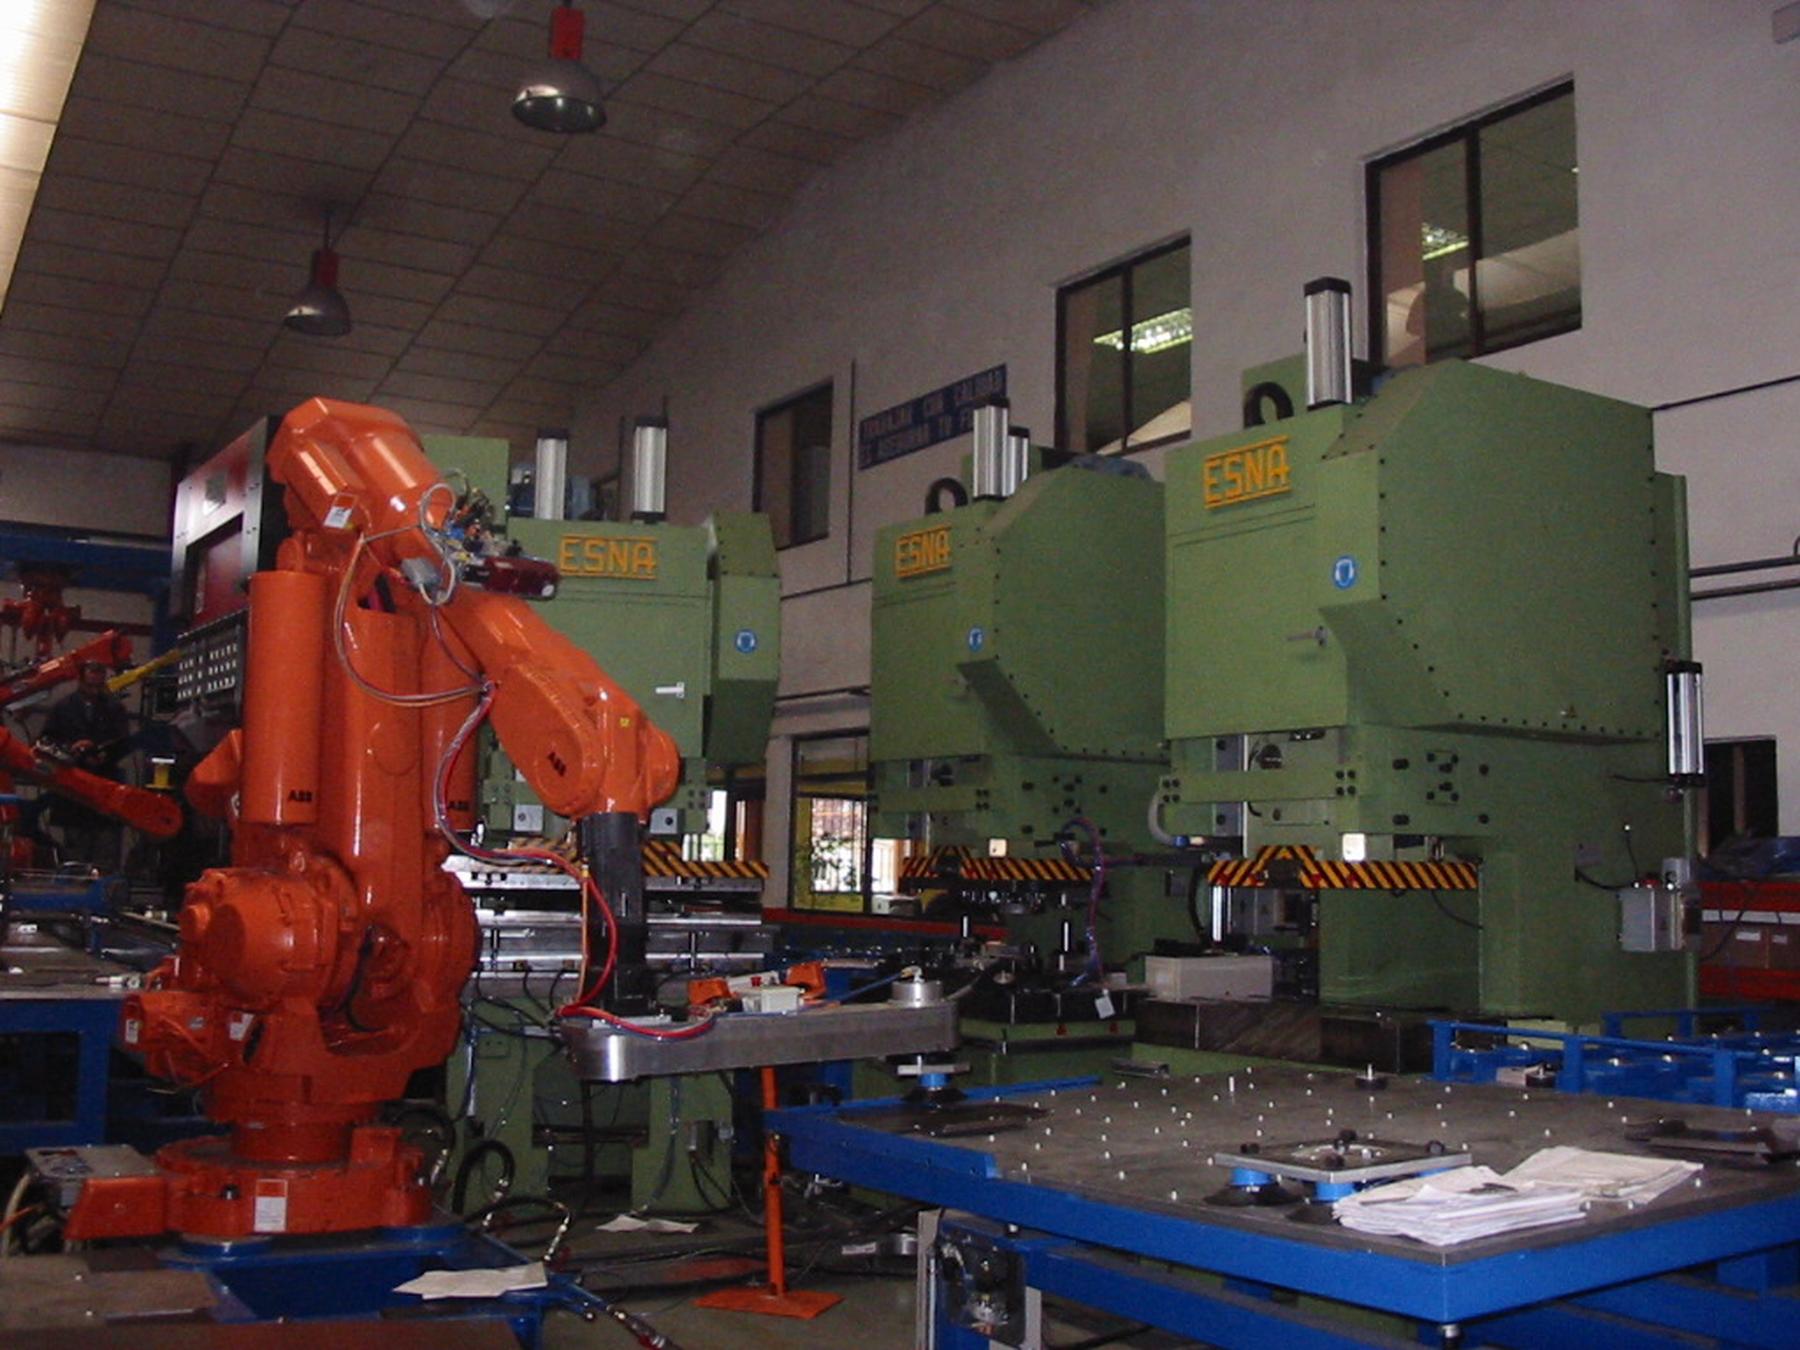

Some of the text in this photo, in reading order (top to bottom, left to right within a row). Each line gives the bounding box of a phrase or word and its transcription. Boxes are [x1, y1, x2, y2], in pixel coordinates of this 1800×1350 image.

[1204, 443, 1289, 503] ESNA
[560, 538, 657, 576] ESNA
[895, 529, 950, 573] ESNA
